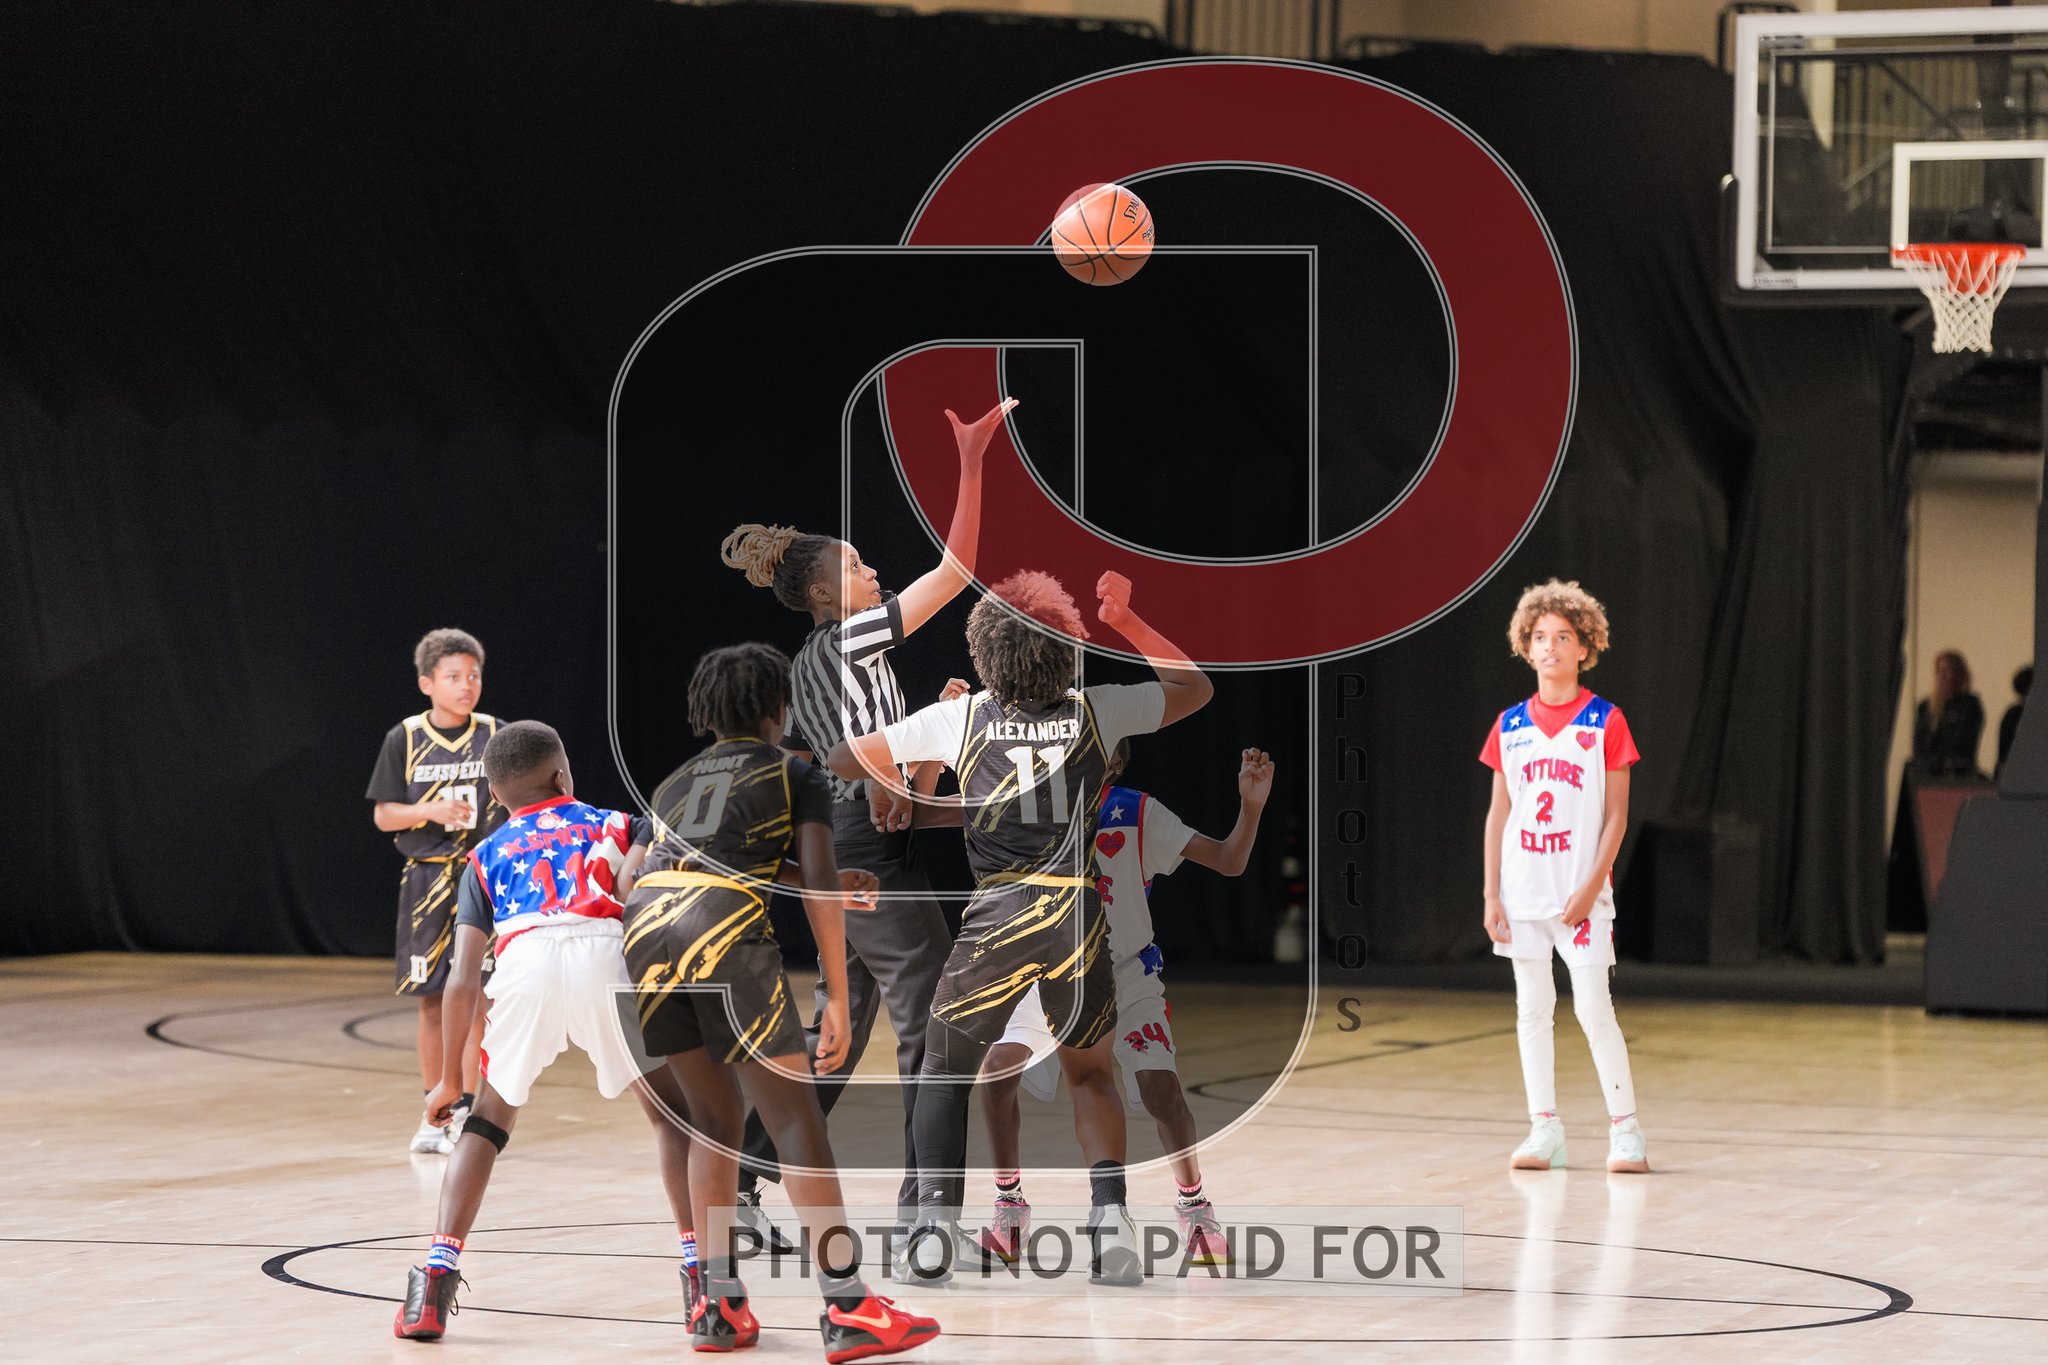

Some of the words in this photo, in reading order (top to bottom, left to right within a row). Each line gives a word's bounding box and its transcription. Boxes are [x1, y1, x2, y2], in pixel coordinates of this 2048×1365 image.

[985, 718, 1081, 742] ALEXANDER
[692, 753, 753, 775] HUNT
[1521, 758, 1585, 792] UTURE
[1005, 745, 1070, 825] 11
[676, 771, 734, 839] 0
[1536, 791, 1554, 826] 2
[1520, 829, 1572, 856] ELITE
[531, 852, 600, 916] 11
[1573, 919, 1591, 950] 2
[435, 1234, 462, 1250] ELITE
